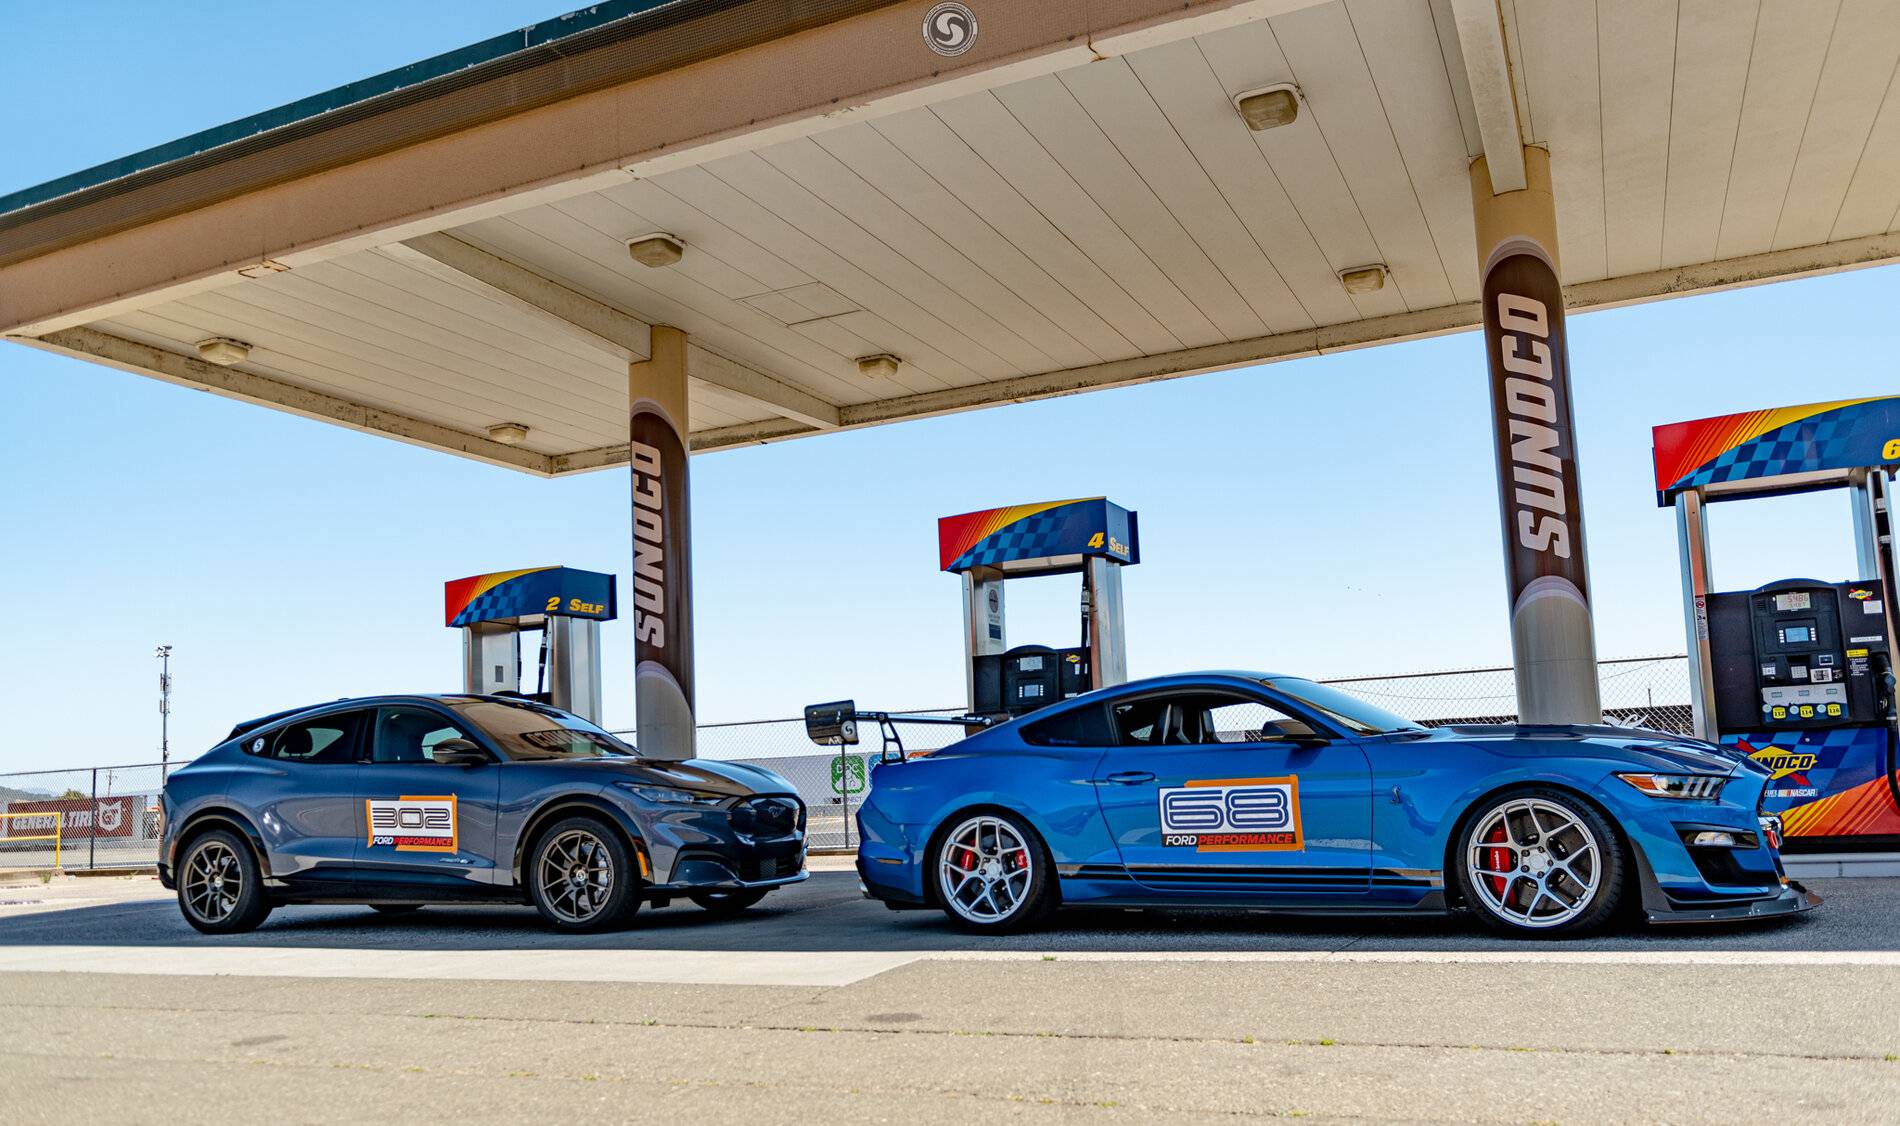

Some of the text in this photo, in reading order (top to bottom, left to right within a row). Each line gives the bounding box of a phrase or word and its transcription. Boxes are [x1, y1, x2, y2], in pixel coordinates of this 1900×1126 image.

[1497, 293, 1571, 559] SUNOCO
[631, 440, 665, 648] SUNOCO
[1088, 532, 1105, 549] 4
[546, 596, 561, 611] 2
[372, 807, 451, 829] 302
[1163, 788, 1289, 829] 68
[373, 836, 453, 846] FORD PERFORMANCE
[1165, 833, 1293, 846] FORD PERFORMANCE
